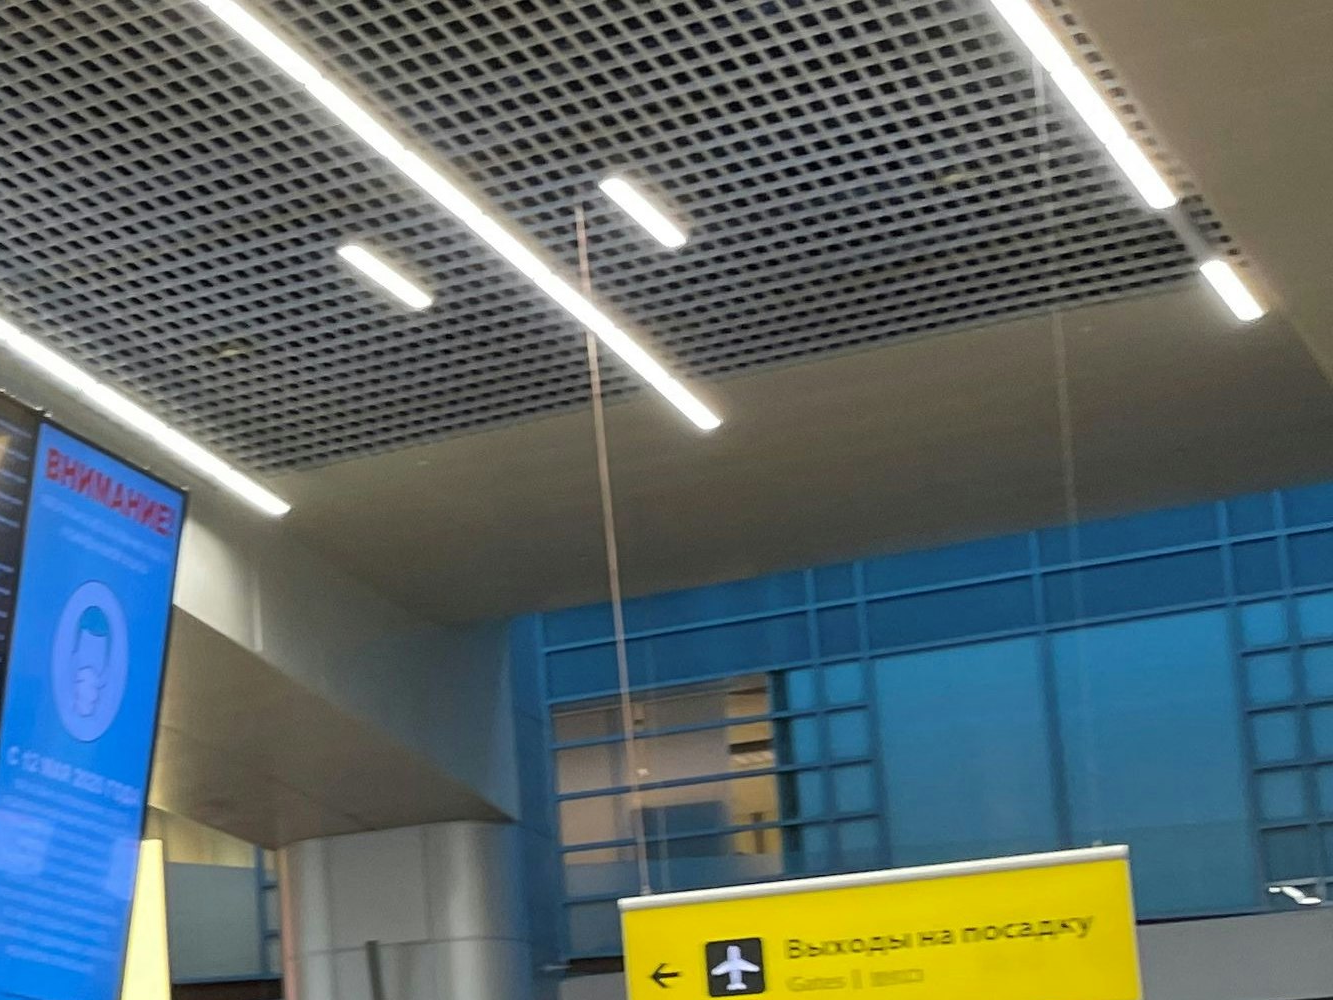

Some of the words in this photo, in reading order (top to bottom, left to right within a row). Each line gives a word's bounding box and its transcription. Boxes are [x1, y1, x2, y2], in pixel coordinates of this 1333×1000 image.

[785, 932, 913, 959] Выходы
[917, 930, 957, 948] на
[961, 916, 1094, 944] посадку
